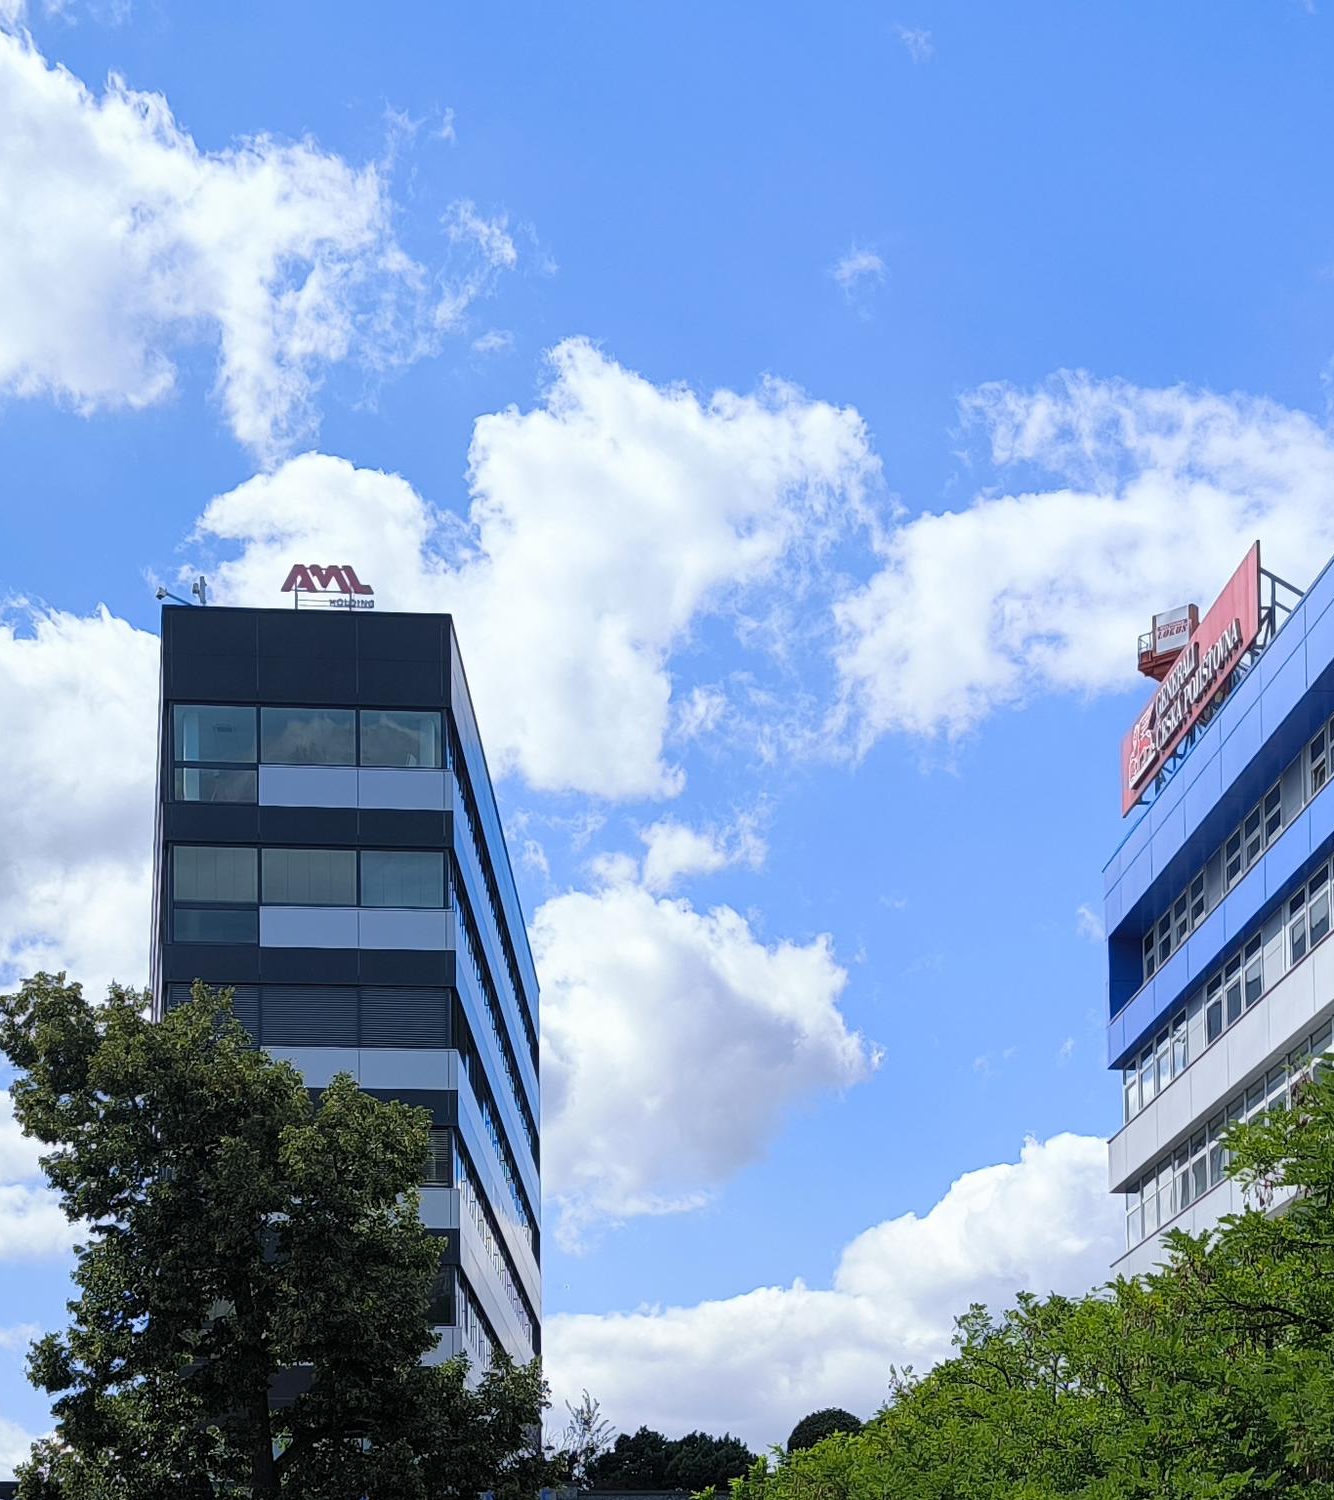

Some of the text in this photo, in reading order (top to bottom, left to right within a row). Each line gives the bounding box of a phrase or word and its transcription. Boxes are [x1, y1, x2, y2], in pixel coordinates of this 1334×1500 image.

[280, 564, 374, 595] AML
[329, 598, 375, 608] HOLDING
[1155, 643, 1198, 717] GENERALI
[1155, 618, 1240, 751] ČESKÁ POJIŠŤOVNA
